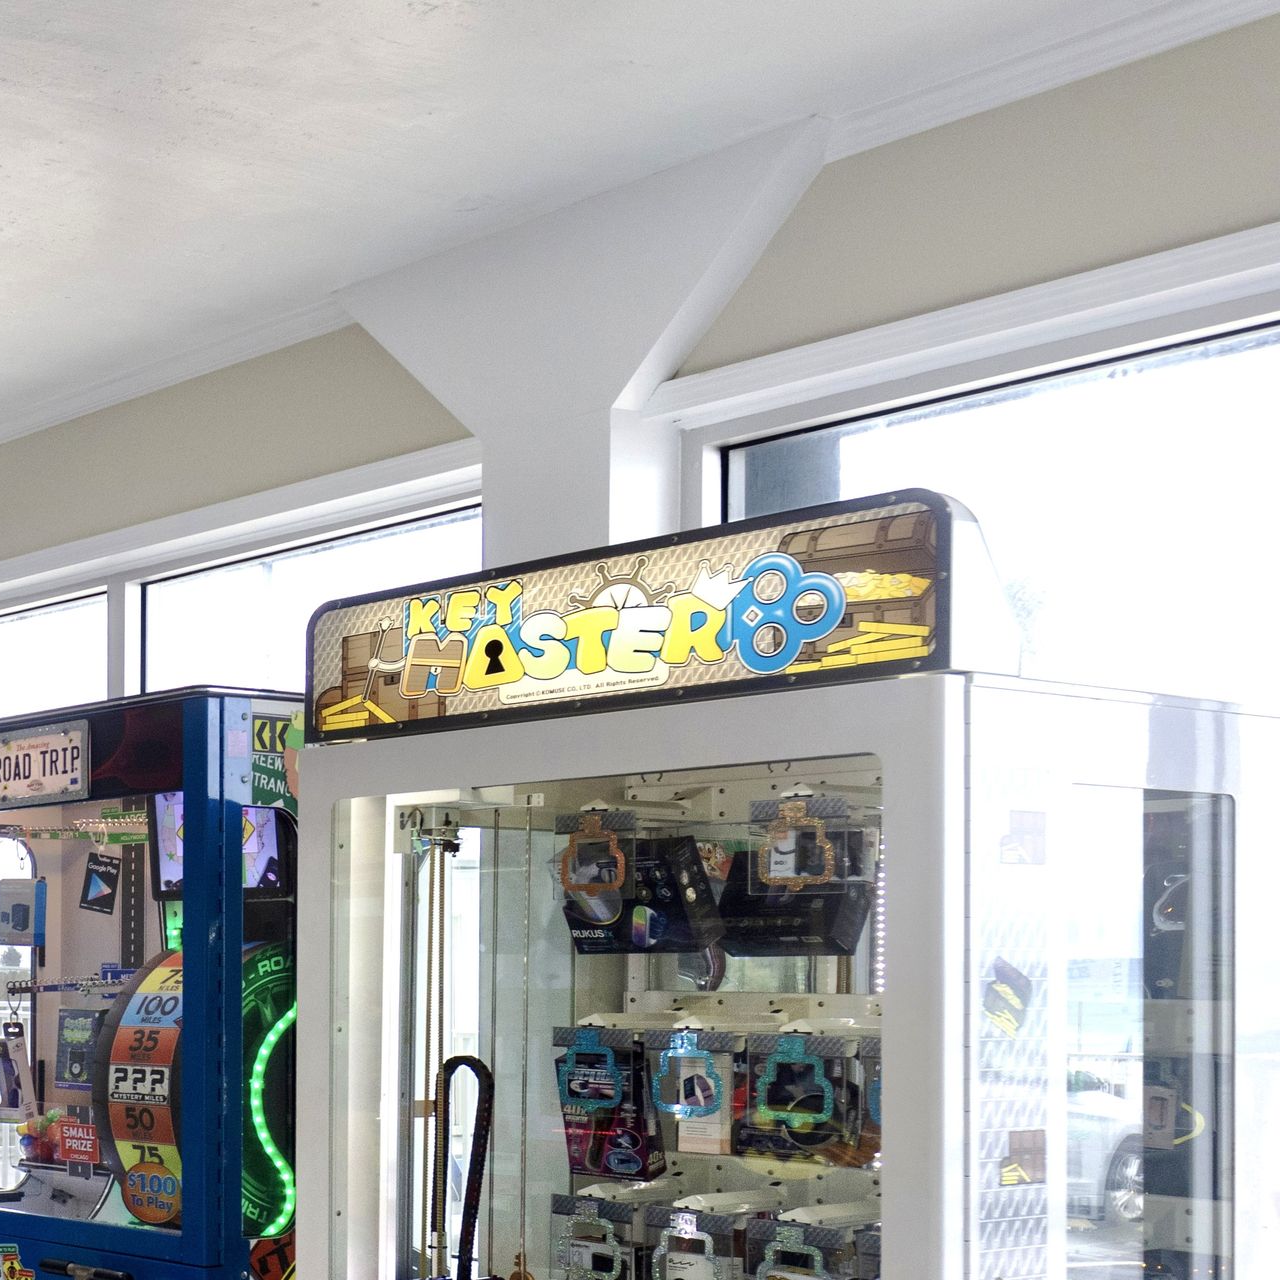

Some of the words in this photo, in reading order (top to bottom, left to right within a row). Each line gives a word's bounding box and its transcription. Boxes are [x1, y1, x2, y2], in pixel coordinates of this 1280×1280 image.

[406, 580, 523, 638] KEY
[399, 590, 728, 699] MASTER
[506, 690, 535, 700] Copyright
[606, 679, 626, 688] Rights
[40, 745, 80, 778] TRIP
[251, 754, 288, 772] REEW
[88, 862, 106, 873] Google
[107, 865, 118, 875] Play
[135, 995, 180, 1017] 100
[141, 1016, 162, 1024] MILES
[128, 1029, 161, 1052] 35
[113, 1093, 143, 1101] MYSTERY
[144, 1094, 165, 1102] MILES
[124, 1106, 155, 1131] 50
[62, 1126, 96, 1139] SMALL
[65, 1138, 94, 1152] PRIZE
[131, 1144, 165, 1165] 75
[127, 1171, 177, 1196] $1.00
[131, 1194, 144, 1206] To
[146, 1194, 173, 1213] Play
